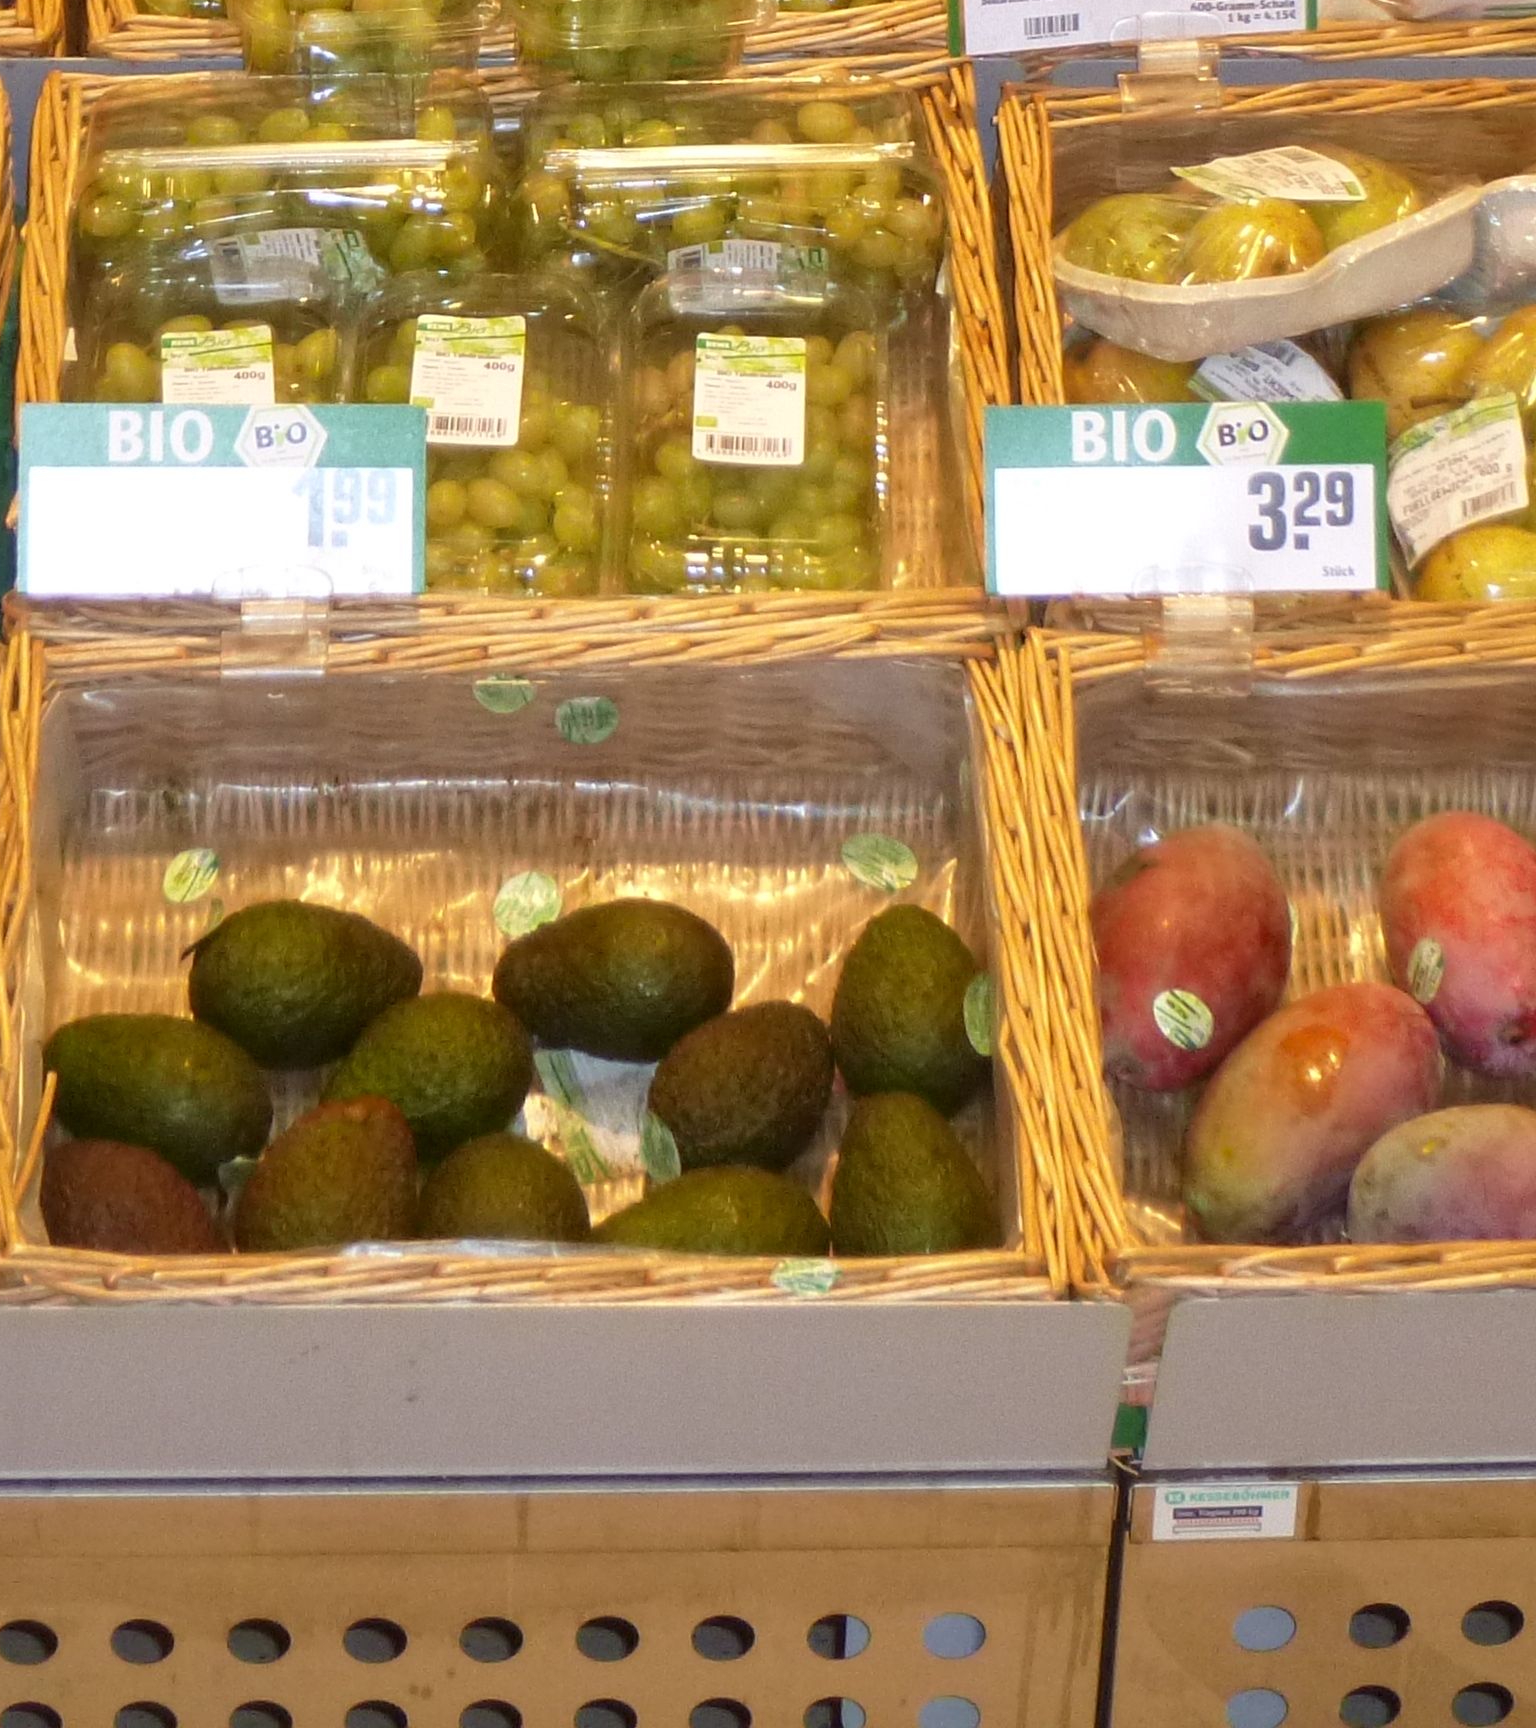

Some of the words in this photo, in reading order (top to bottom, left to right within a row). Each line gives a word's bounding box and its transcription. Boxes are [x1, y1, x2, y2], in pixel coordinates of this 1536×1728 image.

[108, 410, 213, 463] BIO
[1071, 409, 1176, 463] BIO
[292, 467, 397, 547] 1.99
[1248, 471, 1355, 551] 3.29
[1322, 565, 1355, 577] Stück
